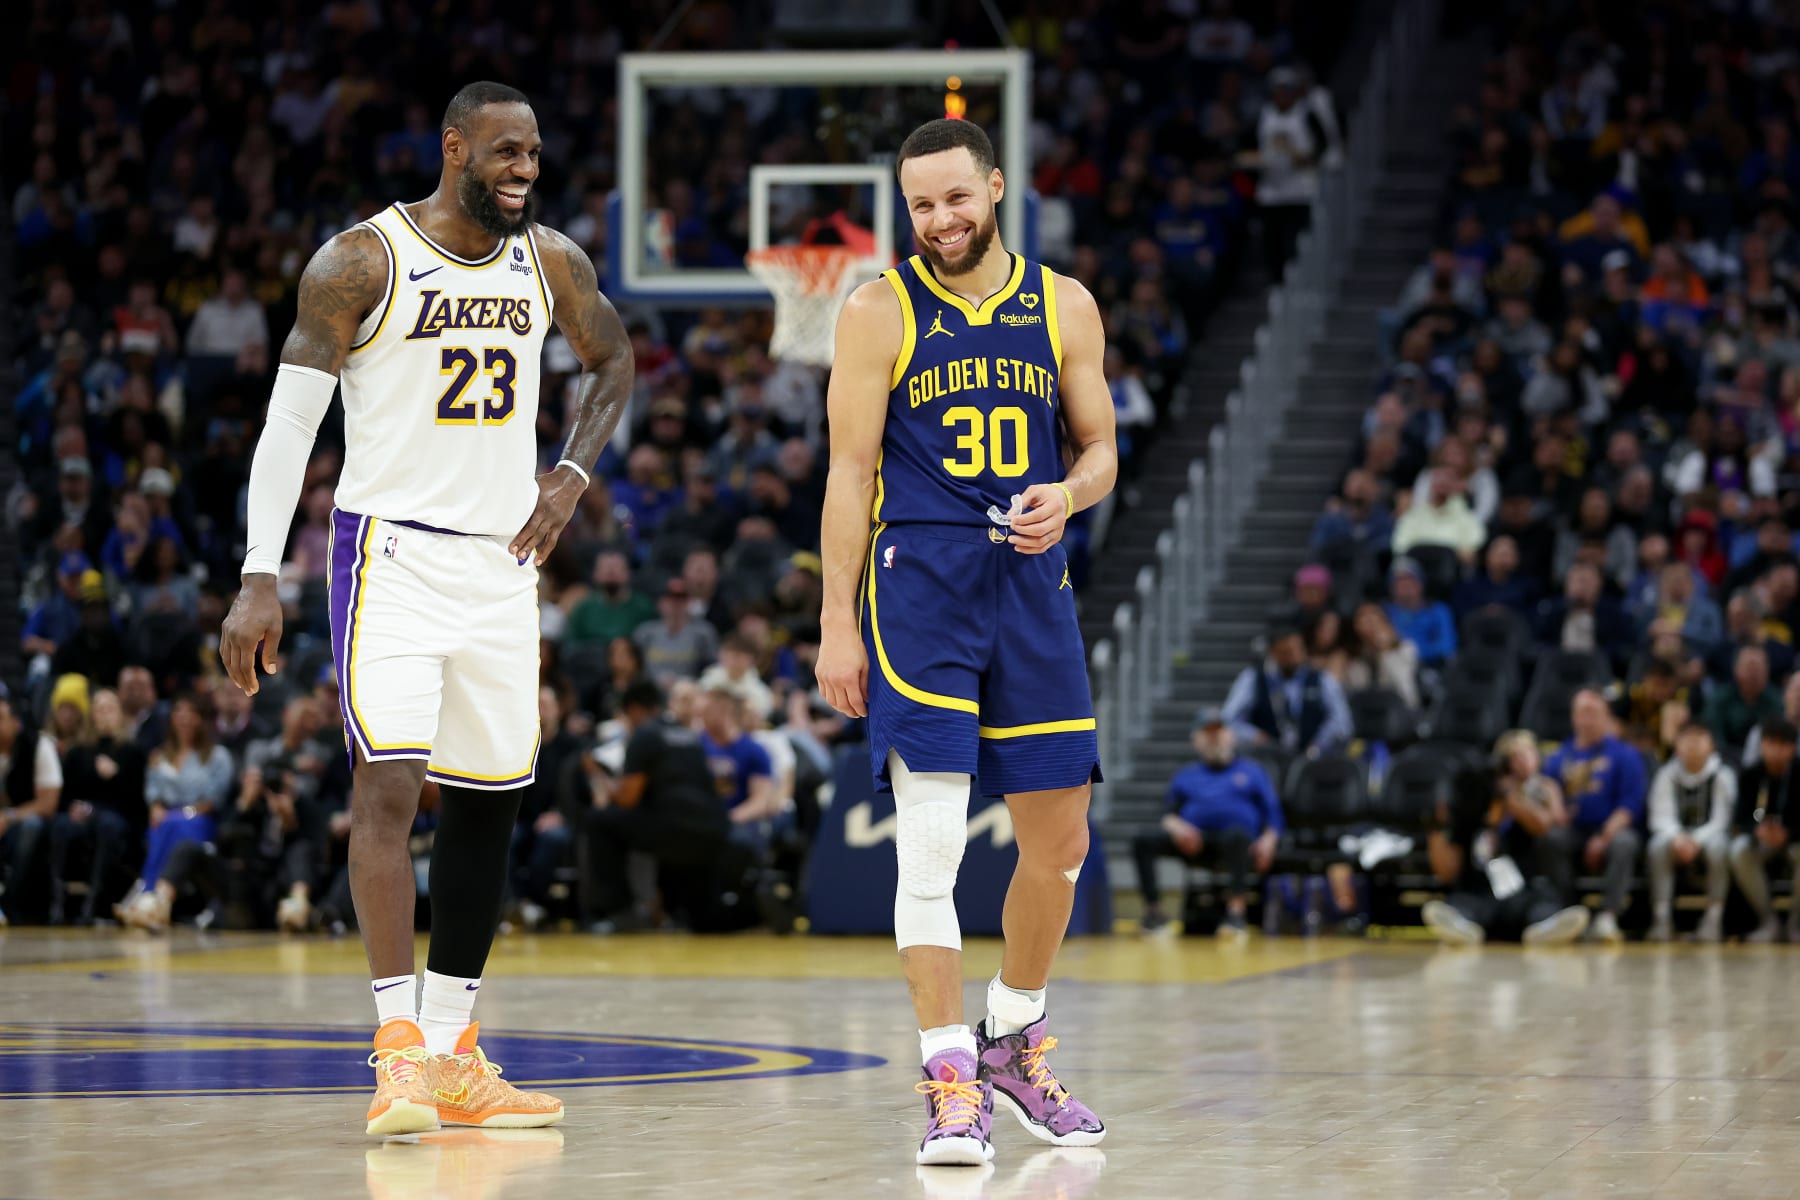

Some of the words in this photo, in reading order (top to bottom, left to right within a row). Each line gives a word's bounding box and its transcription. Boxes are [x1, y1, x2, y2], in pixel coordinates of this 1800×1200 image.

[510, 262, 533, 276] bibigo
[403, 288, 532, 342] LAKERS
[1000, 313, 1042, 325] Rakuten
[435, 346, 517, 426] 23
[908, 357, 989, 409] GOLDEN
[995, 357, 1054, 408] STATE
[942, 406, 1030, 477] 30
